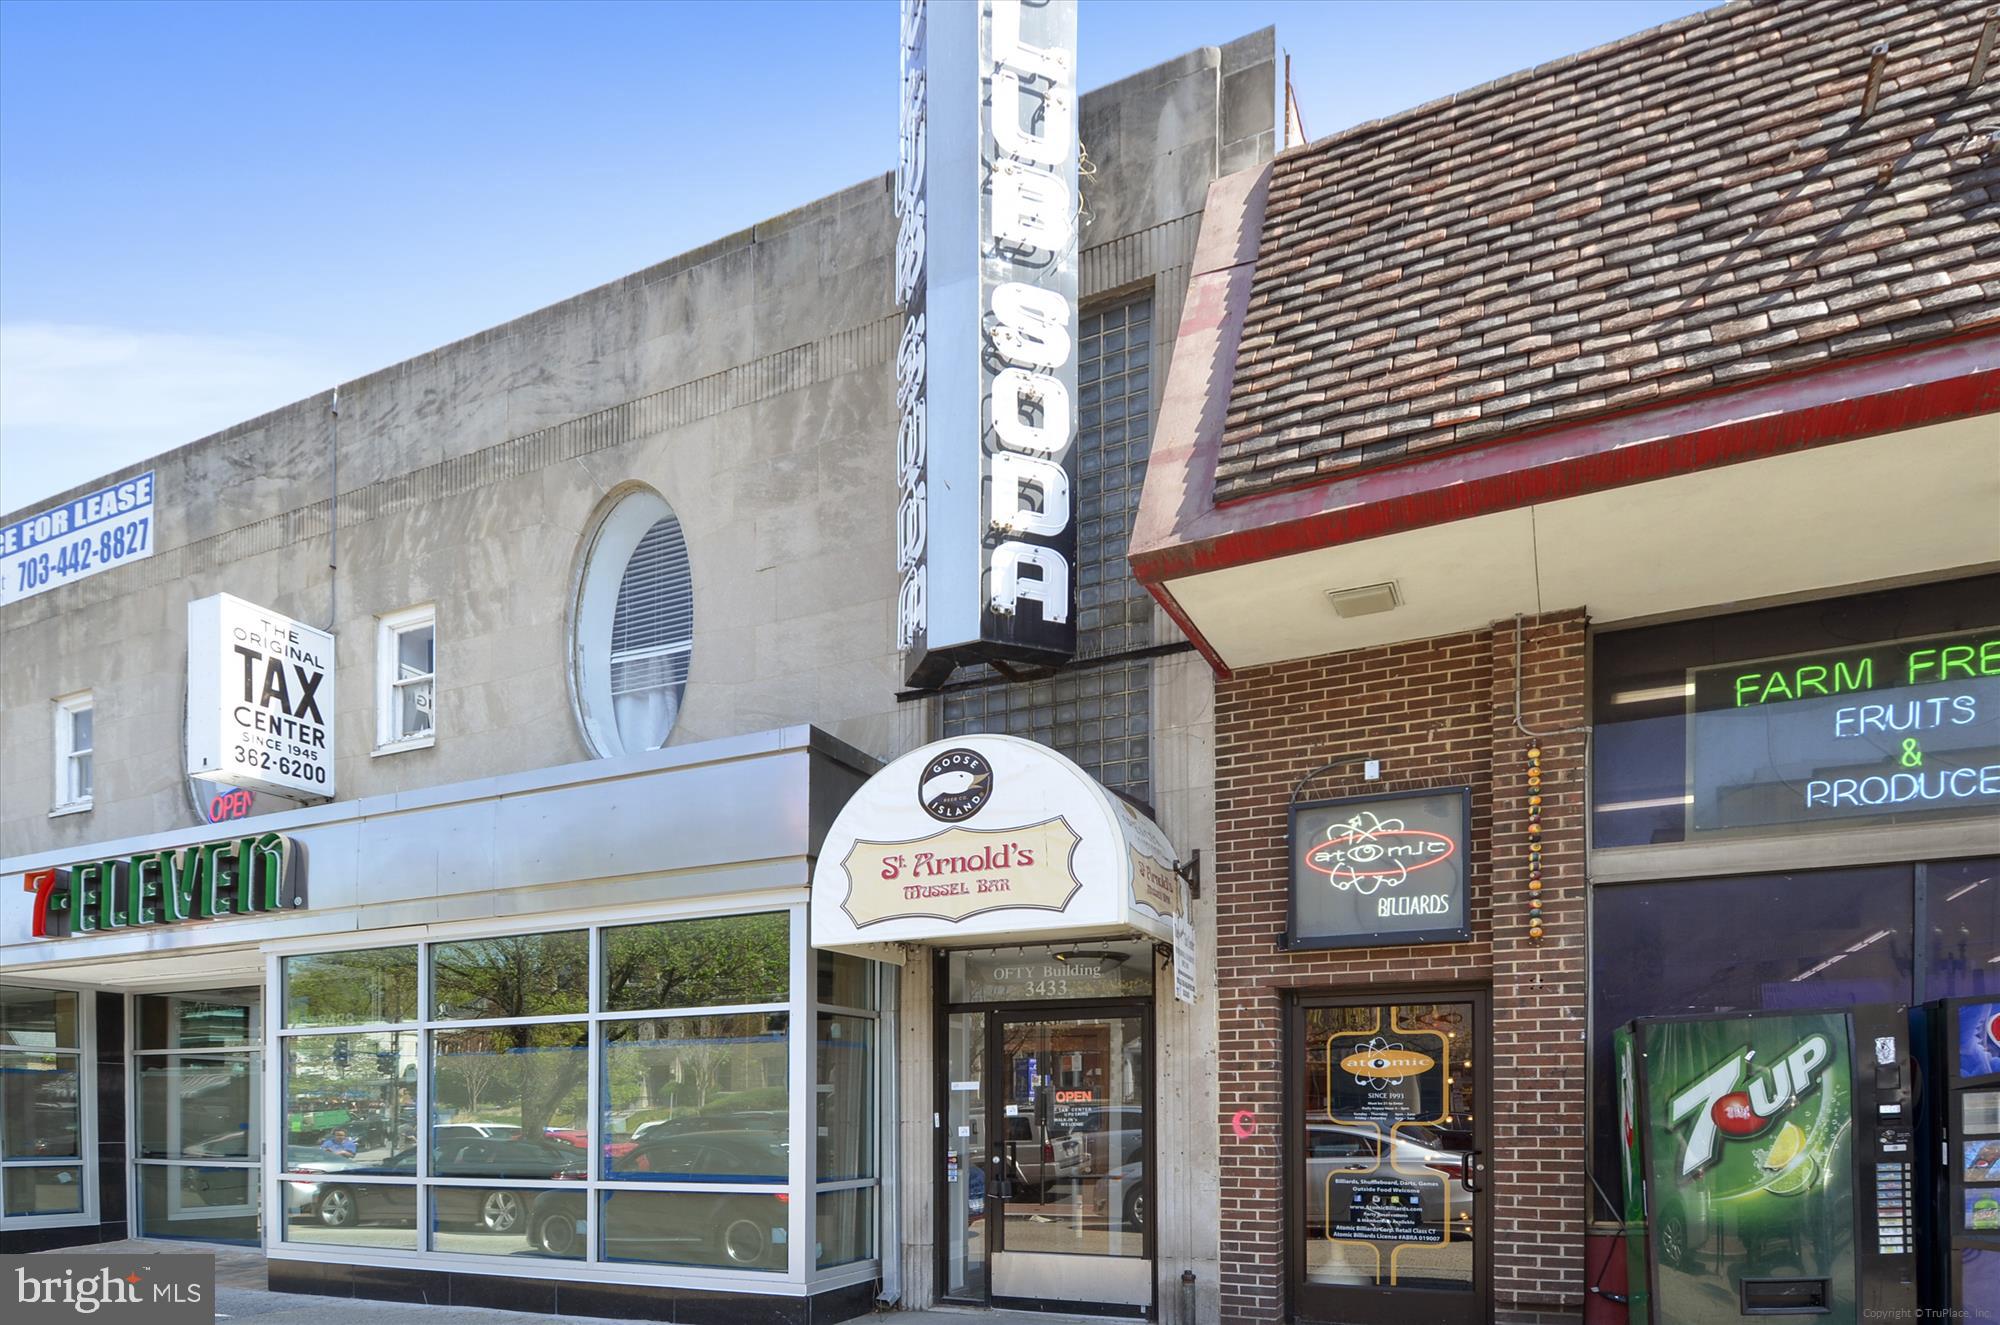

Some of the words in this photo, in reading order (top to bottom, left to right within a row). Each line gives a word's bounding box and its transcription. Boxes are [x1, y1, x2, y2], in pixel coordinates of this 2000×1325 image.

[22, 509, 68, 547] FOR
[74, 477, 151, 528] LEASE
[18, 518, 148, 592] 703-442-8827
[261, 619, 299, 645] THE
[233, 627, 325, 669] ORIGINAL
[234, 644, 325, 725] TAX
[1735, 658, 1873, 707] FARM
[234, 706, 326, 749] CENTER
[1835, 695, 1977, 738] FRUITS
[242, 732, 281, 751] SINCE
[288, 743, 318, 761] 1945
[1901, 737, 1923, 768] &
[933, 755, 979, 773] GOOSE
[1806, 765, 2000, 808] PRODUCE
[209, 790, 256, 822] OPEN
[931, 795, 981, 817] ISLAND
[913, 843, 1035, 878] Arnold's
[976, 878, 1011, 893] BAR
[1377, 894, 1449, 917] BILLIARDS
[993, 966, 1035, 980] OFTY
[1043, 964, 1101, 979] Building
[1025, 979, 1067, 997] 3433
[1055, 1090, 1092, 1103] OPEN
